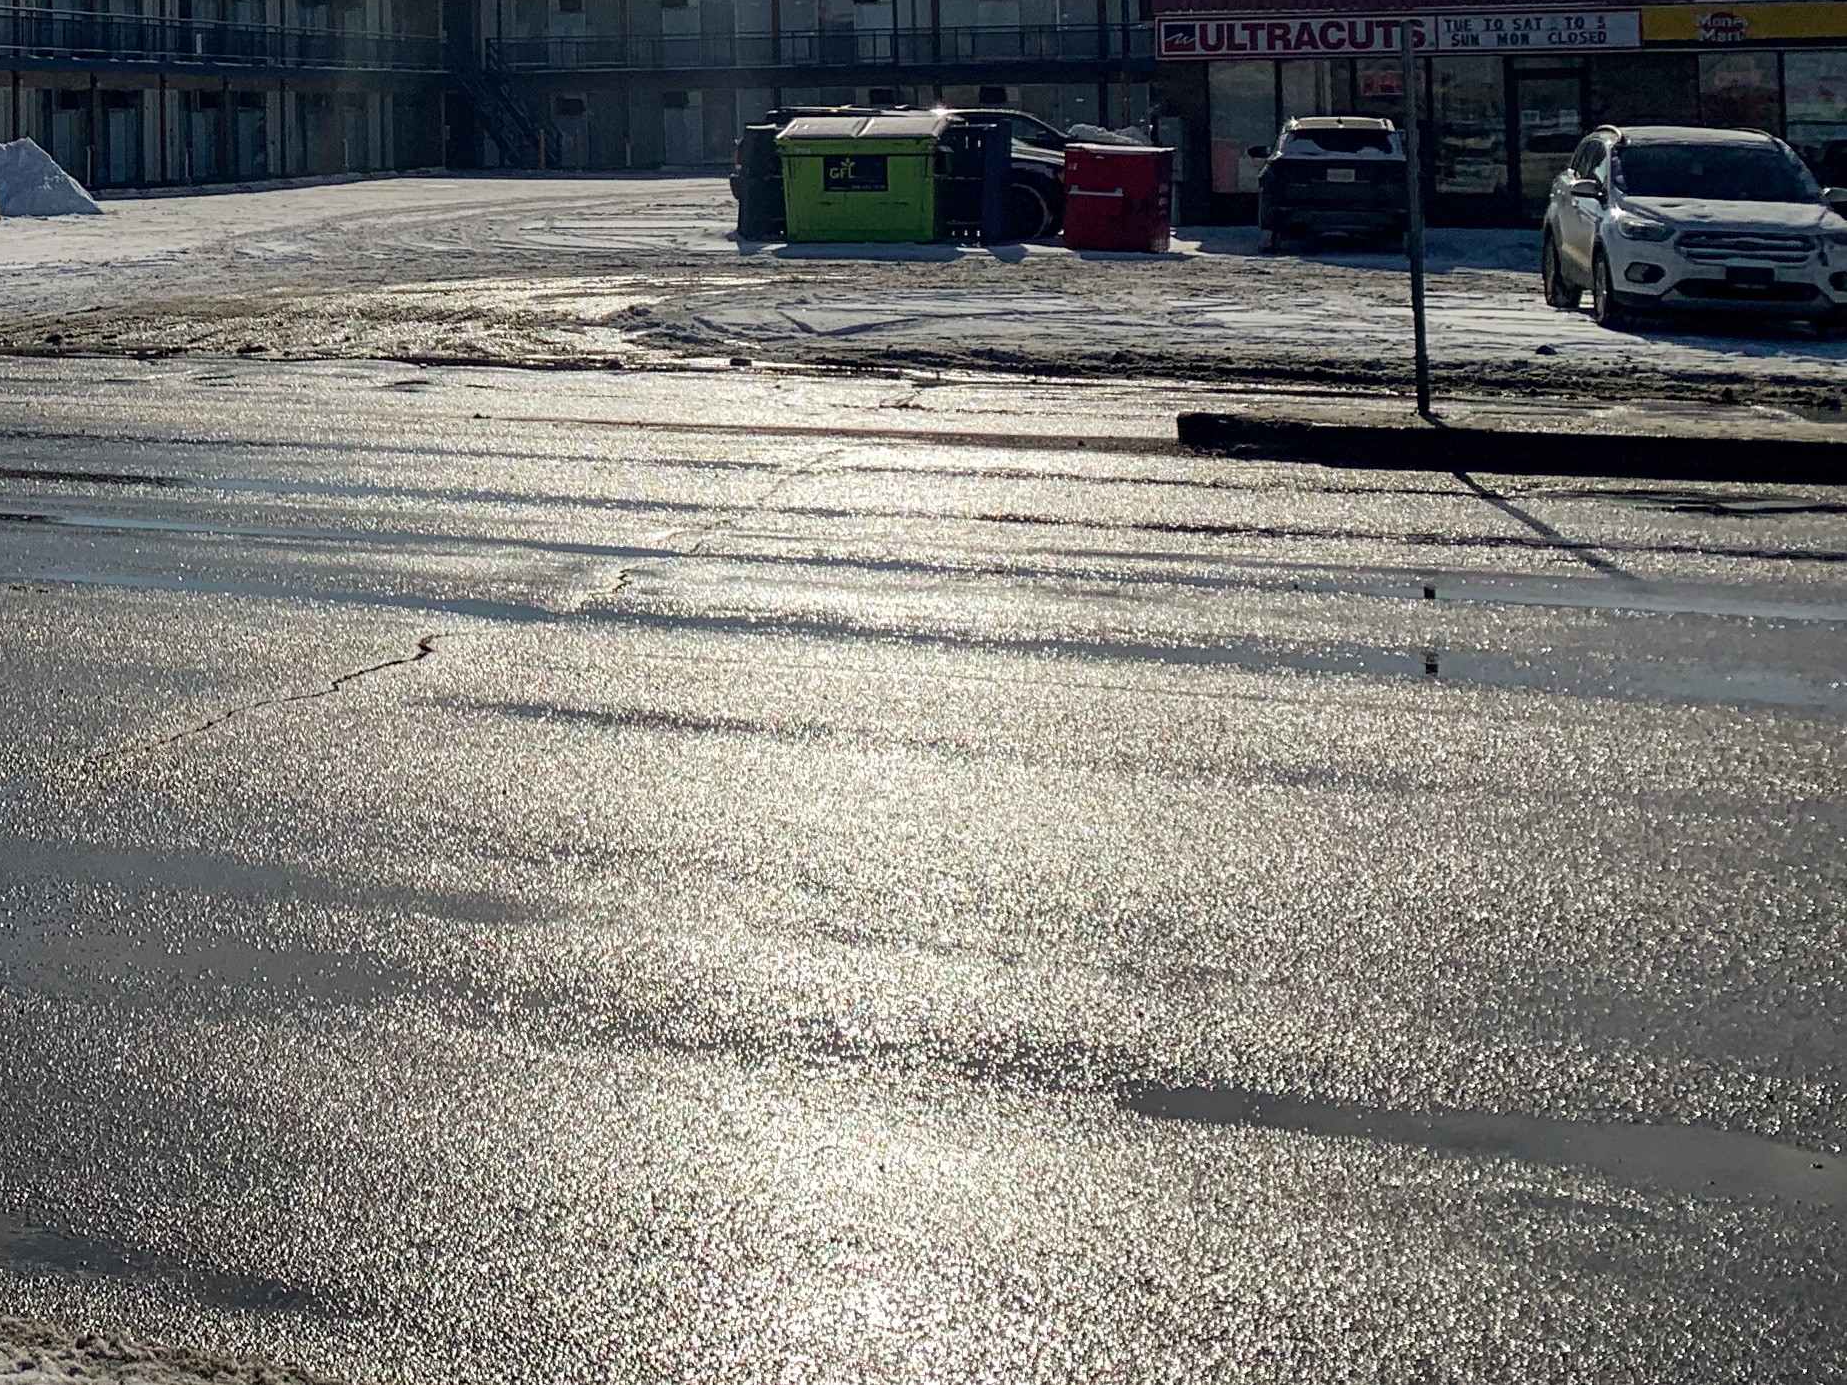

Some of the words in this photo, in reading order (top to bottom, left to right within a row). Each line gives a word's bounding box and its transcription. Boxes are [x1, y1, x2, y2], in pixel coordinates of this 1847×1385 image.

[1444, 19, 1472, 33] TUE
[1513, 17, 1543, 31] SAT
[1199, 20, 1426, 52] ULTRACUTS
[1451, 33, 1479, 47] SUN
[1497, 33, 1530, 46] MON
[1548, 31, 1607, 45] CLOSED
[829, 166, 856, 180] GFL
